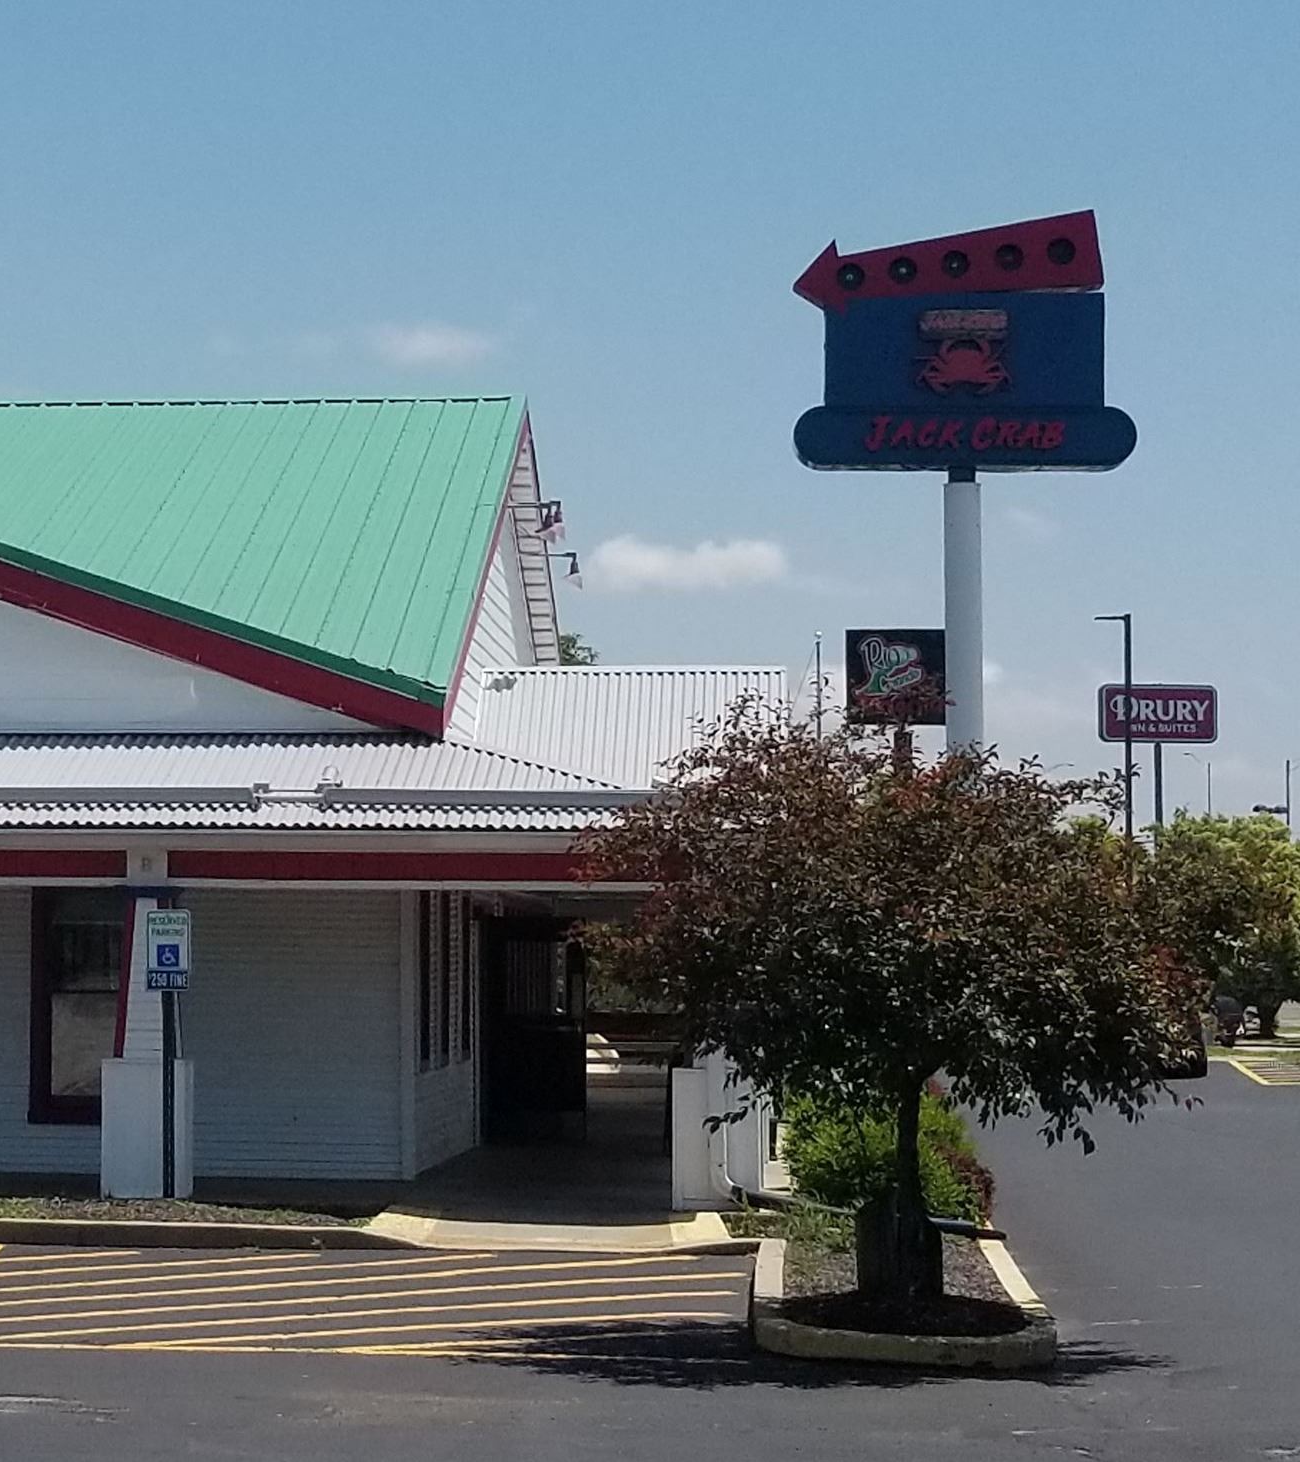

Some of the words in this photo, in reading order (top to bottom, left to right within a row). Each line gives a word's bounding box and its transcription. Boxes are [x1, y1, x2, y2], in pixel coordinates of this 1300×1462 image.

[864, 416, 963, 451] JACK
[971, 416, 1065, 449] CRAB
[1110, 694, 1210, 721] DRURY
[1129, 723, 1146, 732] NN
[1159, 723, 1197, 733] SUITES
[151, 928, 185, 936] PARKING
[170, 973, 188, 987] FINE
